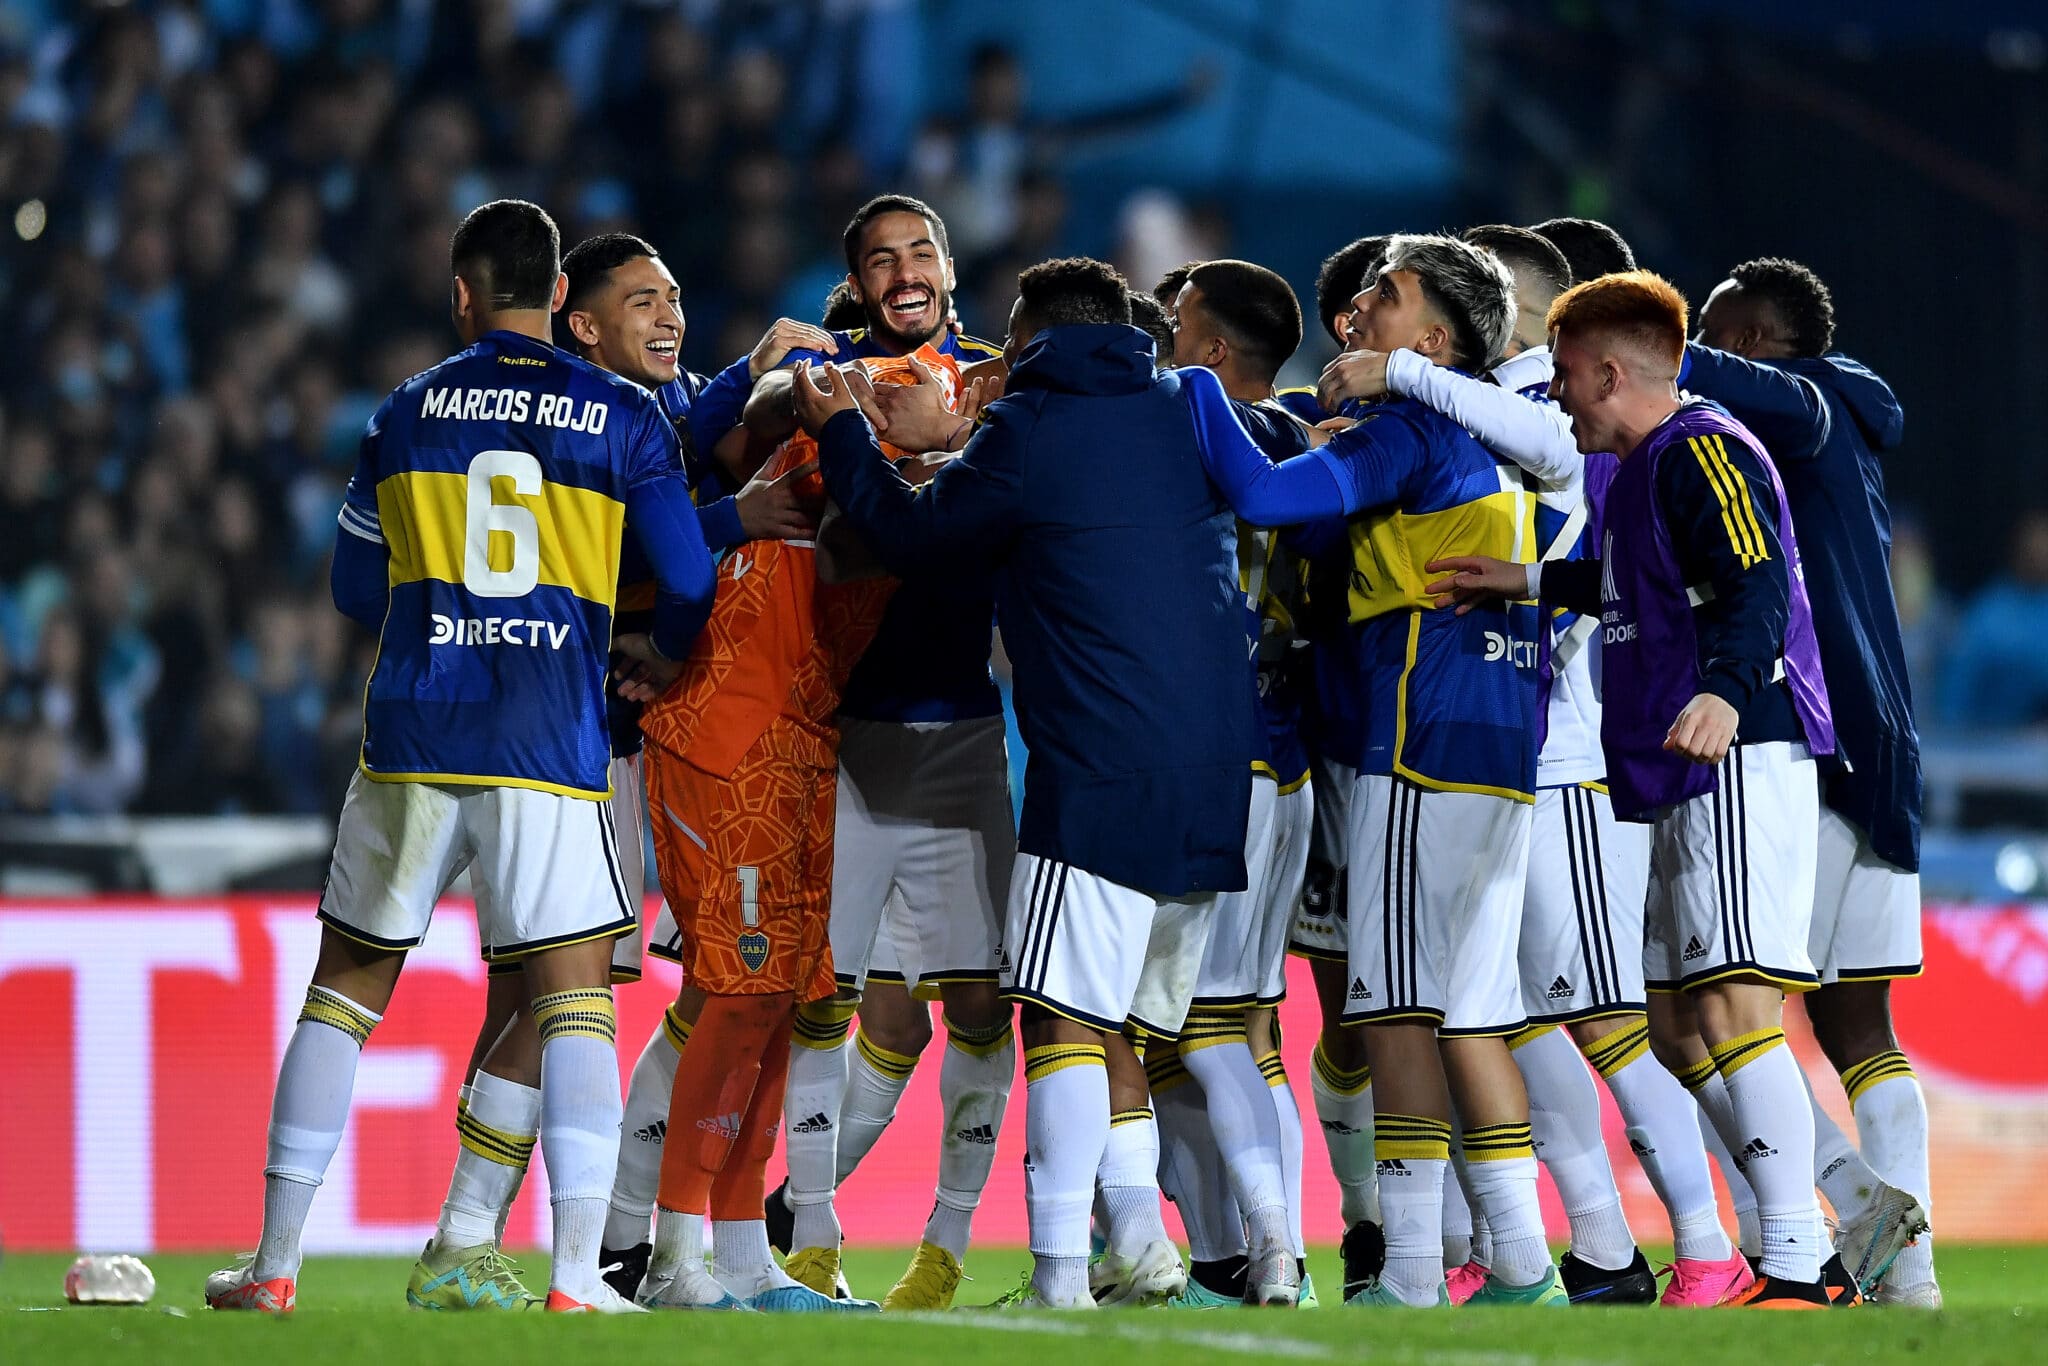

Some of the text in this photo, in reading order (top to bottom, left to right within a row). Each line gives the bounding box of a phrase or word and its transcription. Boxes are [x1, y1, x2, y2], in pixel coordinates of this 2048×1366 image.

[497, 355, 547, 367] XENEIZE
[421, 388, 608, 435] MARCOS ROJO
[463, 450, 543, 598] 6
[428, 613, 571, 650] DIRECTV
[737, 866, 758, 927] 1
[1303, 858, 1348, 922] 3
[741, 945, 766, 954] CABJ
[1682, 948, 1708, 961] adidas
[1349, 991, 1372, 1000] adidas
[1547, 989, 1575, 999] adidas
[696, 1119, 738, 1139] adida
[792, 1122, 833, 1133] adidas
